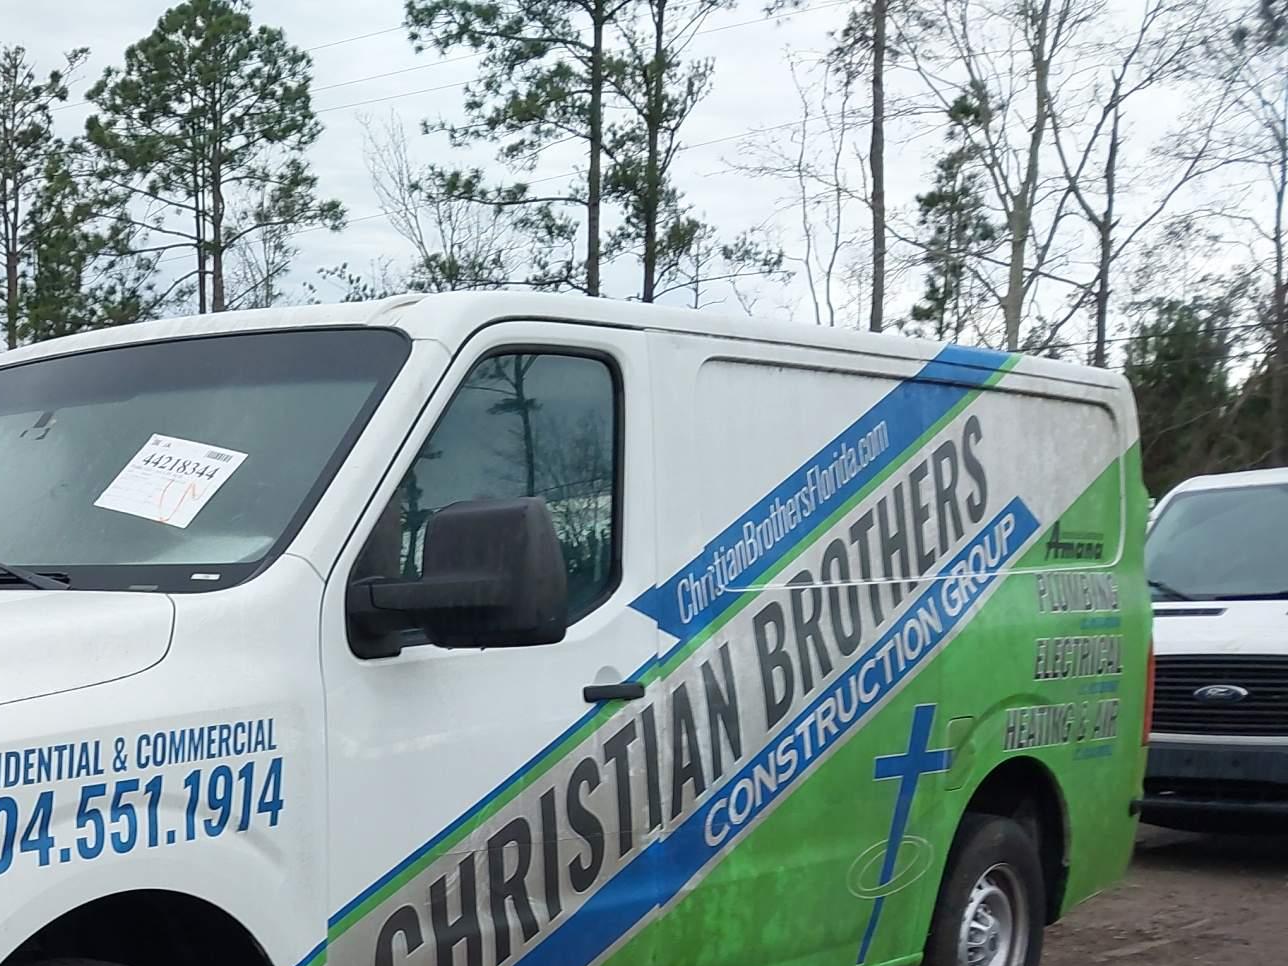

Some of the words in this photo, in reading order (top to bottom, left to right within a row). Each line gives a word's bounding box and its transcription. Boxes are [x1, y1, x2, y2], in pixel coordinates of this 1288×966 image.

[139, 452, 220, 481] 44218344
[676, 419, 890, 625] ChristianBrothersFlorida.com
[752, 413, 988, 731] BROTHERS
[703, 601, 945, 848] CONSTRUCTION
[940, 512, 1017, 618] GROUP
[1033, 634, 1124, 681] ELECTRICAL
[112, 736, 128, 773] &
[136, 717, 278, 770] COMMERCIAL
[1002, 702, 1075, 752] HEATING
[1089, 698, 1120, 741] AIR
